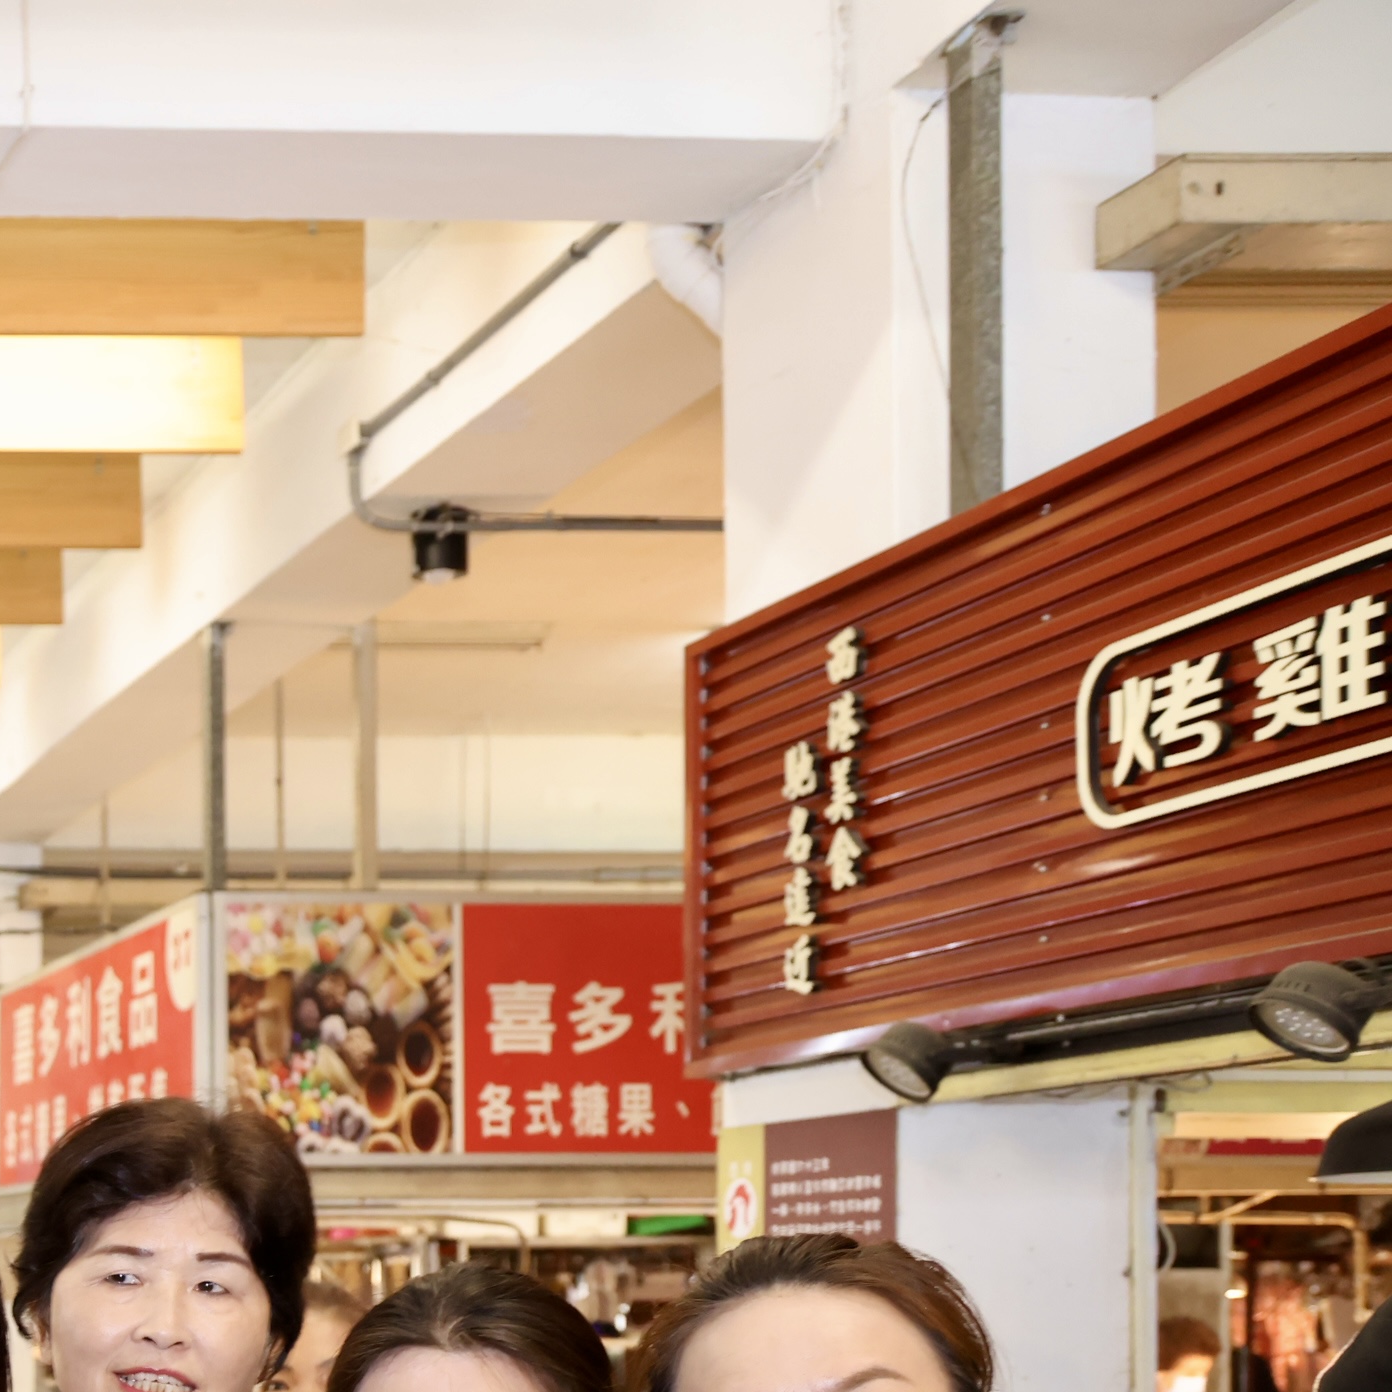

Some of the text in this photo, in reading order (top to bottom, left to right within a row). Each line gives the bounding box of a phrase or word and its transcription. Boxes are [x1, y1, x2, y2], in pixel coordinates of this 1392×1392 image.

[1108, 595, 1388, 788] 烤雞
[12, 950, 158, 1086] 喜多利食品
